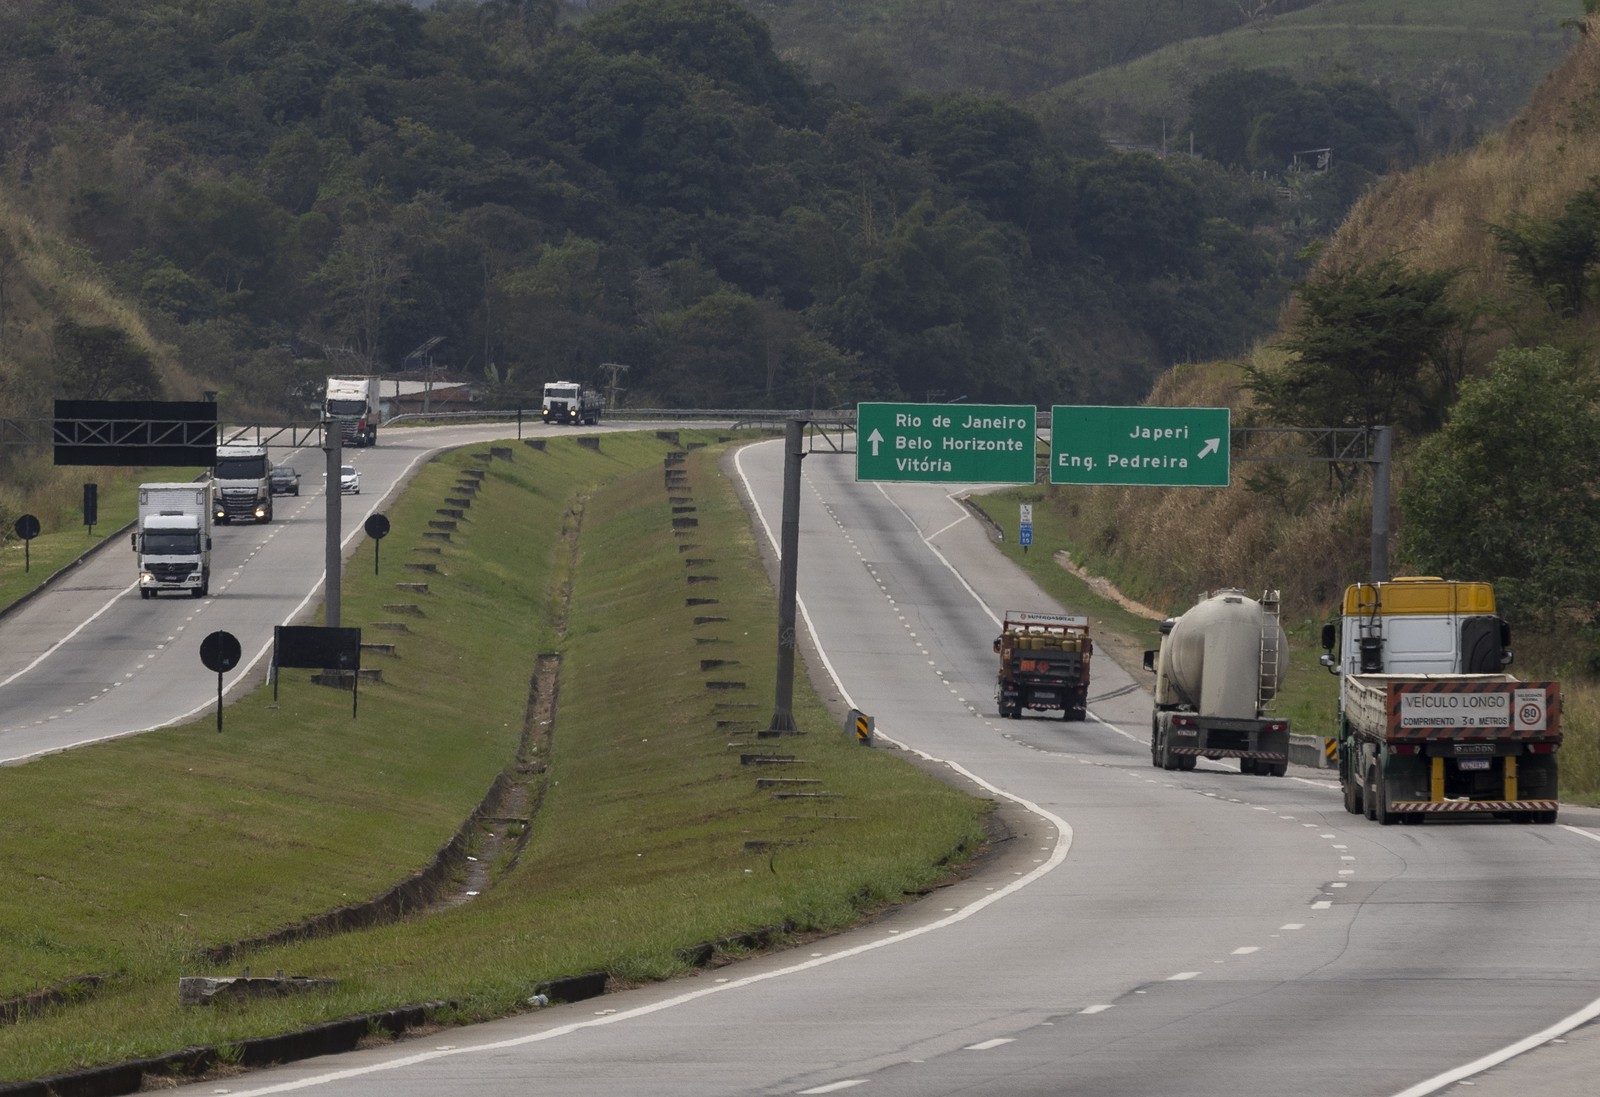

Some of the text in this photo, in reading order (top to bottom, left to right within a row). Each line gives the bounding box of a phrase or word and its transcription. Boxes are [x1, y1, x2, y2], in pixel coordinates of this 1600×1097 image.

[896, 414, 1027, 429] Rio de Janeiro
[1129, 425, 1188, 441] Japeri
[895, 436, 1023, 451] Belo Horizonte
[896, 456, 952, 472] Vitória
[1059, 453, 1188, 471] Eng. Pedreira
[1405, 694, 1505, 708] VEÍCULO LONGO
[1523, 708, 1537, 718] 80
[1403, 716, 1508, 726] COMPRIMENTO 30 METROS
